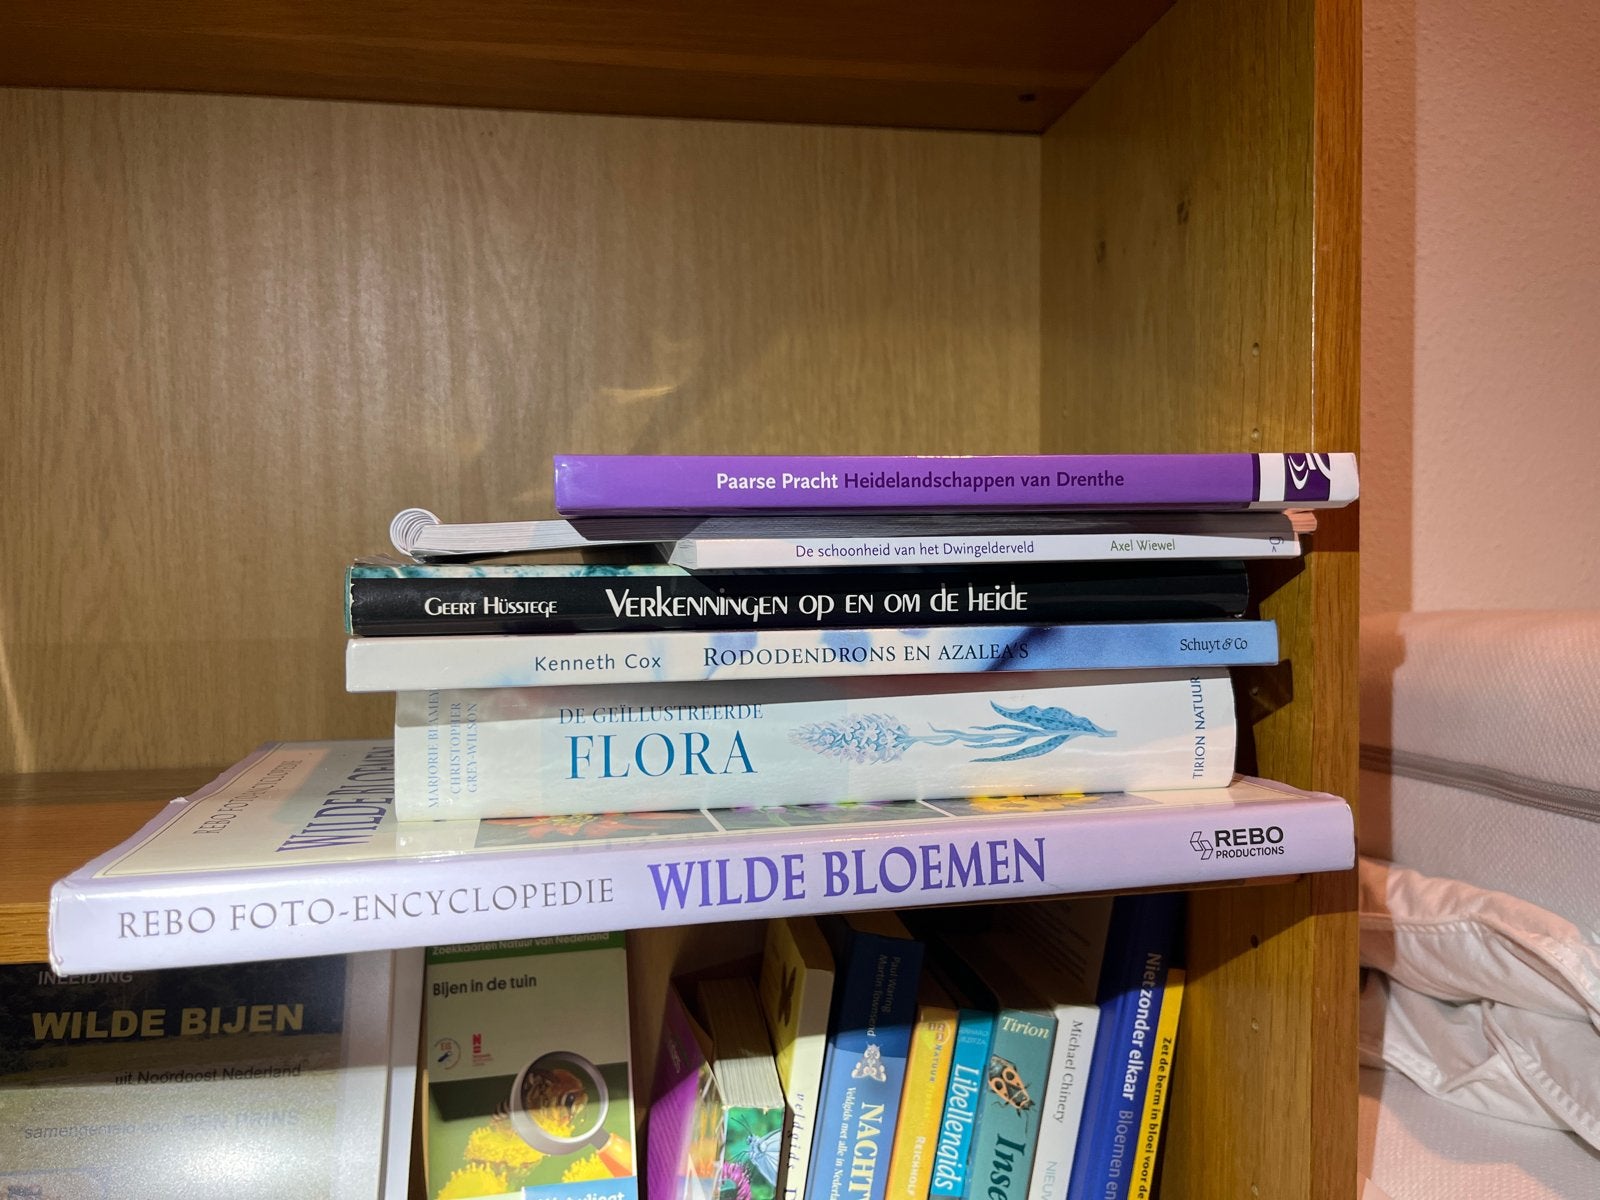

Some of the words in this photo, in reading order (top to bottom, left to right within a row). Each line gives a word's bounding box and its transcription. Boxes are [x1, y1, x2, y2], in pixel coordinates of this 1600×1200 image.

[716, 472, 776, 490] Paarse
[782, 471, 838, 490] Pracht
[844, 470, 1015, 492] Heidelandschappen
[1020, 475, 1050, 487] van
[1056, 470, 1124, 487] Drenthe
[795, 545, 814, 557] De
[818, 543, 890, 558] schoonheid
[893, 547, 915, 556] van
[919, 543, 940, 556] het
[943, 540, 1035, 557] Dwingelderveld
[1110, 539, 1133, 552] Axel
[1136, 538, 1176, 552] Wiewel
[424, 597, 477, 616] GEERT
[845, 593, 873, 613] EN
[884, 592, 920, 612] OM
[703, 645, 897, 667] RODODENDRONS
[904, 645, 931, 661] EN
[938, 643, 1029, 661] AZALEA'S
[1180, 638, 1221, 653] Schuyt
[1234, 637, 1248, 650] Co
[535, 654, 615, 672] Kenneth
[624, 653, 661, 669] Cox
[560, 707, 585, 725] DE
[592, 703, 764, 724] GEÏLLUSTREERDE
[1190, 676, 1206, 730] NATUUR
[449, 702, 461, 794] CHRISTOPHER
[466, 703, 478, 793] GREY-WILSON
[564, 730, 758, 780] FLORA
[1192, 735, 1206, 779] TIRION
[275, 797, 394, 853] WILDE
[1214, 826, 1284, 847] REBO
[1215, 845, 1285, 859] PRODUCTIONS
[118, 906, 216, 939] REBO
[230, 878, 614, 932] FOTO-ENCYCLOPEDIE
[647, 854, 806, 911] WILDE
[822, 837, 1046, 898] BLOEMEN
[432, 942, 497, 956] Zoekkaarten
[500, 940, 533, 950] Natuur
[535, 937, 555, 946] van
[874, 954, 888, 992] Martin
[890, 956, 901, 979] Paul
[1141, 952, 1162, 986] Niet
[432, 982, 468, 998] Bijen
[470, 979, 483, 992] in
[486, 977, 507, 991] de
[511, 974, 537, 988] tuin
[880, 979, 899, 1014] Waring
[32, 1008, 166, 1041] WILDE
[180, 1003, 305, 1037] BIJEN
[866, 991, 884, 1037] Townsend
[1002, 1015, 1050, 1039] Tirion
[1130, 989, 1154, 1049] zonder
[1063, 1019, 1084, 1071] Michael
[1162, 1037, 1172, 1056] Zet
[114, 1071, 133, 1086] uit
[137, 1068, 217, 1086] Noordoost
[222, 1064, 301, 1082] Nederland
[1122, 1049, 1146, 1101] elkaar
[1159, 1057, 1168, 1073] de
[844, 1086, 857, 1122] Veldgids
[1052, 1073, 1074, 1124] Chinery
[1153, 1074, 1167, 1108] berm
[1151, 1109, 1160, 1121] in
[840, 1123, 850, 1139] met
[1108, 1109, 1134, 1178] Bloemen
[1146, 1123, 1158, 1155] bloei
[835, 1155, 843, 1164] in
[836, 1138, 847, 1155] alle
[847, 1102, 885, 1200] NACHT
[907, 1135, 926, 1197] REICHHOLF
[1141, 1156, 1151, 1185] voor
[1137, 1185, 1148, 1199] de
